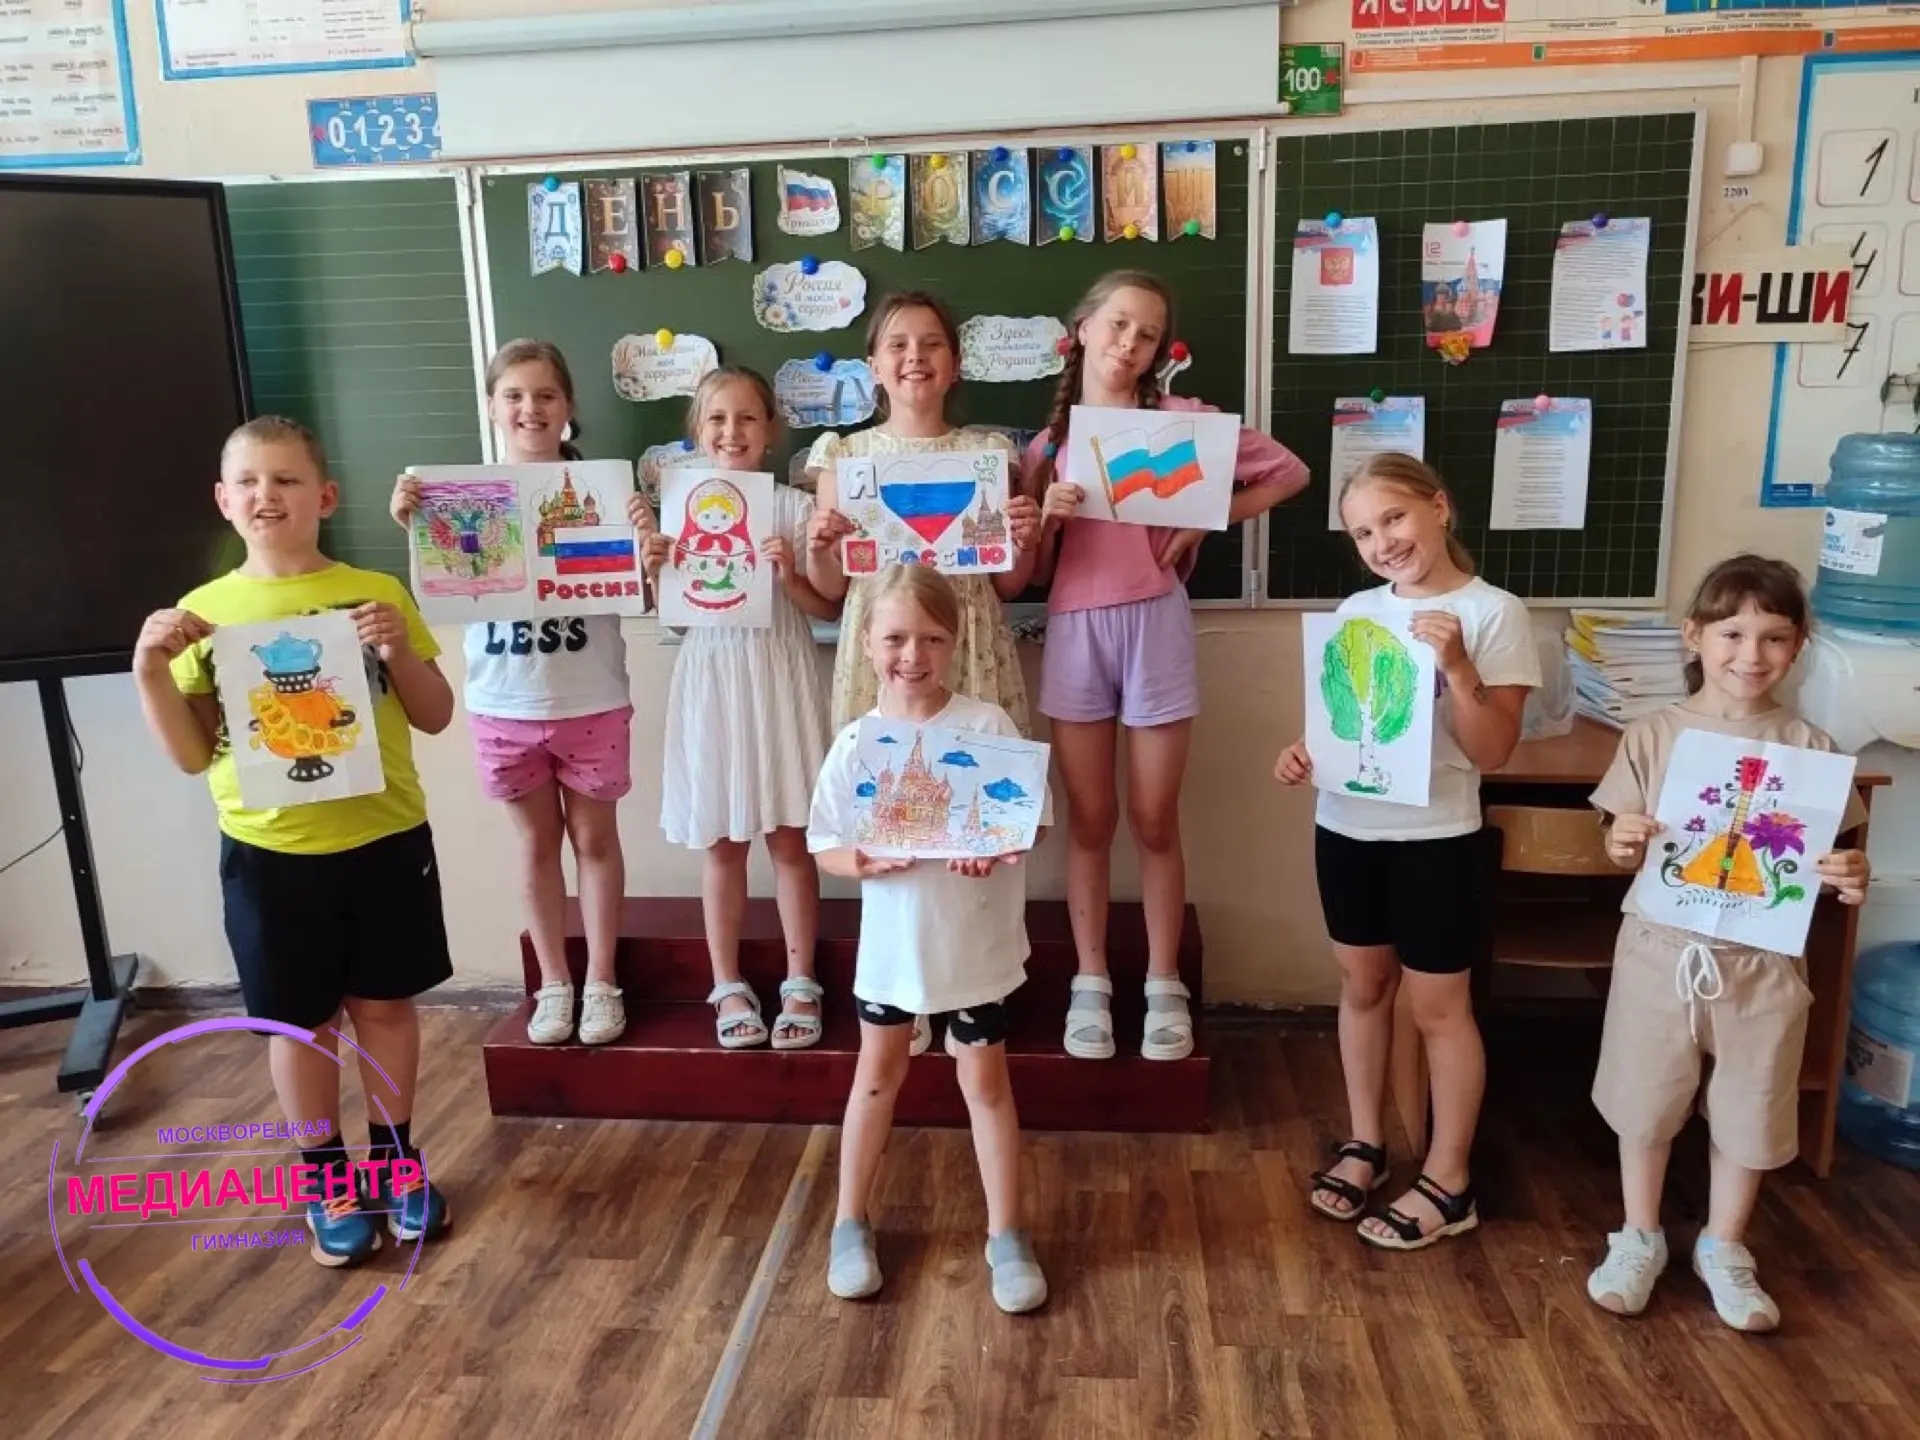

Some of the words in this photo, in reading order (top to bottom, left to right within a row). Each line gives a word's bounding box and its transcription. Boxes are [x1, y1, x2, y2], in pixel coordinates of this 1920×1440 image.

[1284, 67, 1322, 92] 100
[327, 116, 346, 148] 0
[353, 115, 368, 146] 1
[377, 114, 397, 145] 2
[404, 112, 423, 144] 3
[1860, 138, 1890, 197] 1
[545, 191, 740, 243] ДЕНЬ
[1850, 231, 1878, 289] 4
[1837, 321, 1870, 379] 7
[849, 462, 878, 500] Я
[536, 579, 640, 601] Россия
[484, 616, 588, 655] LESS
